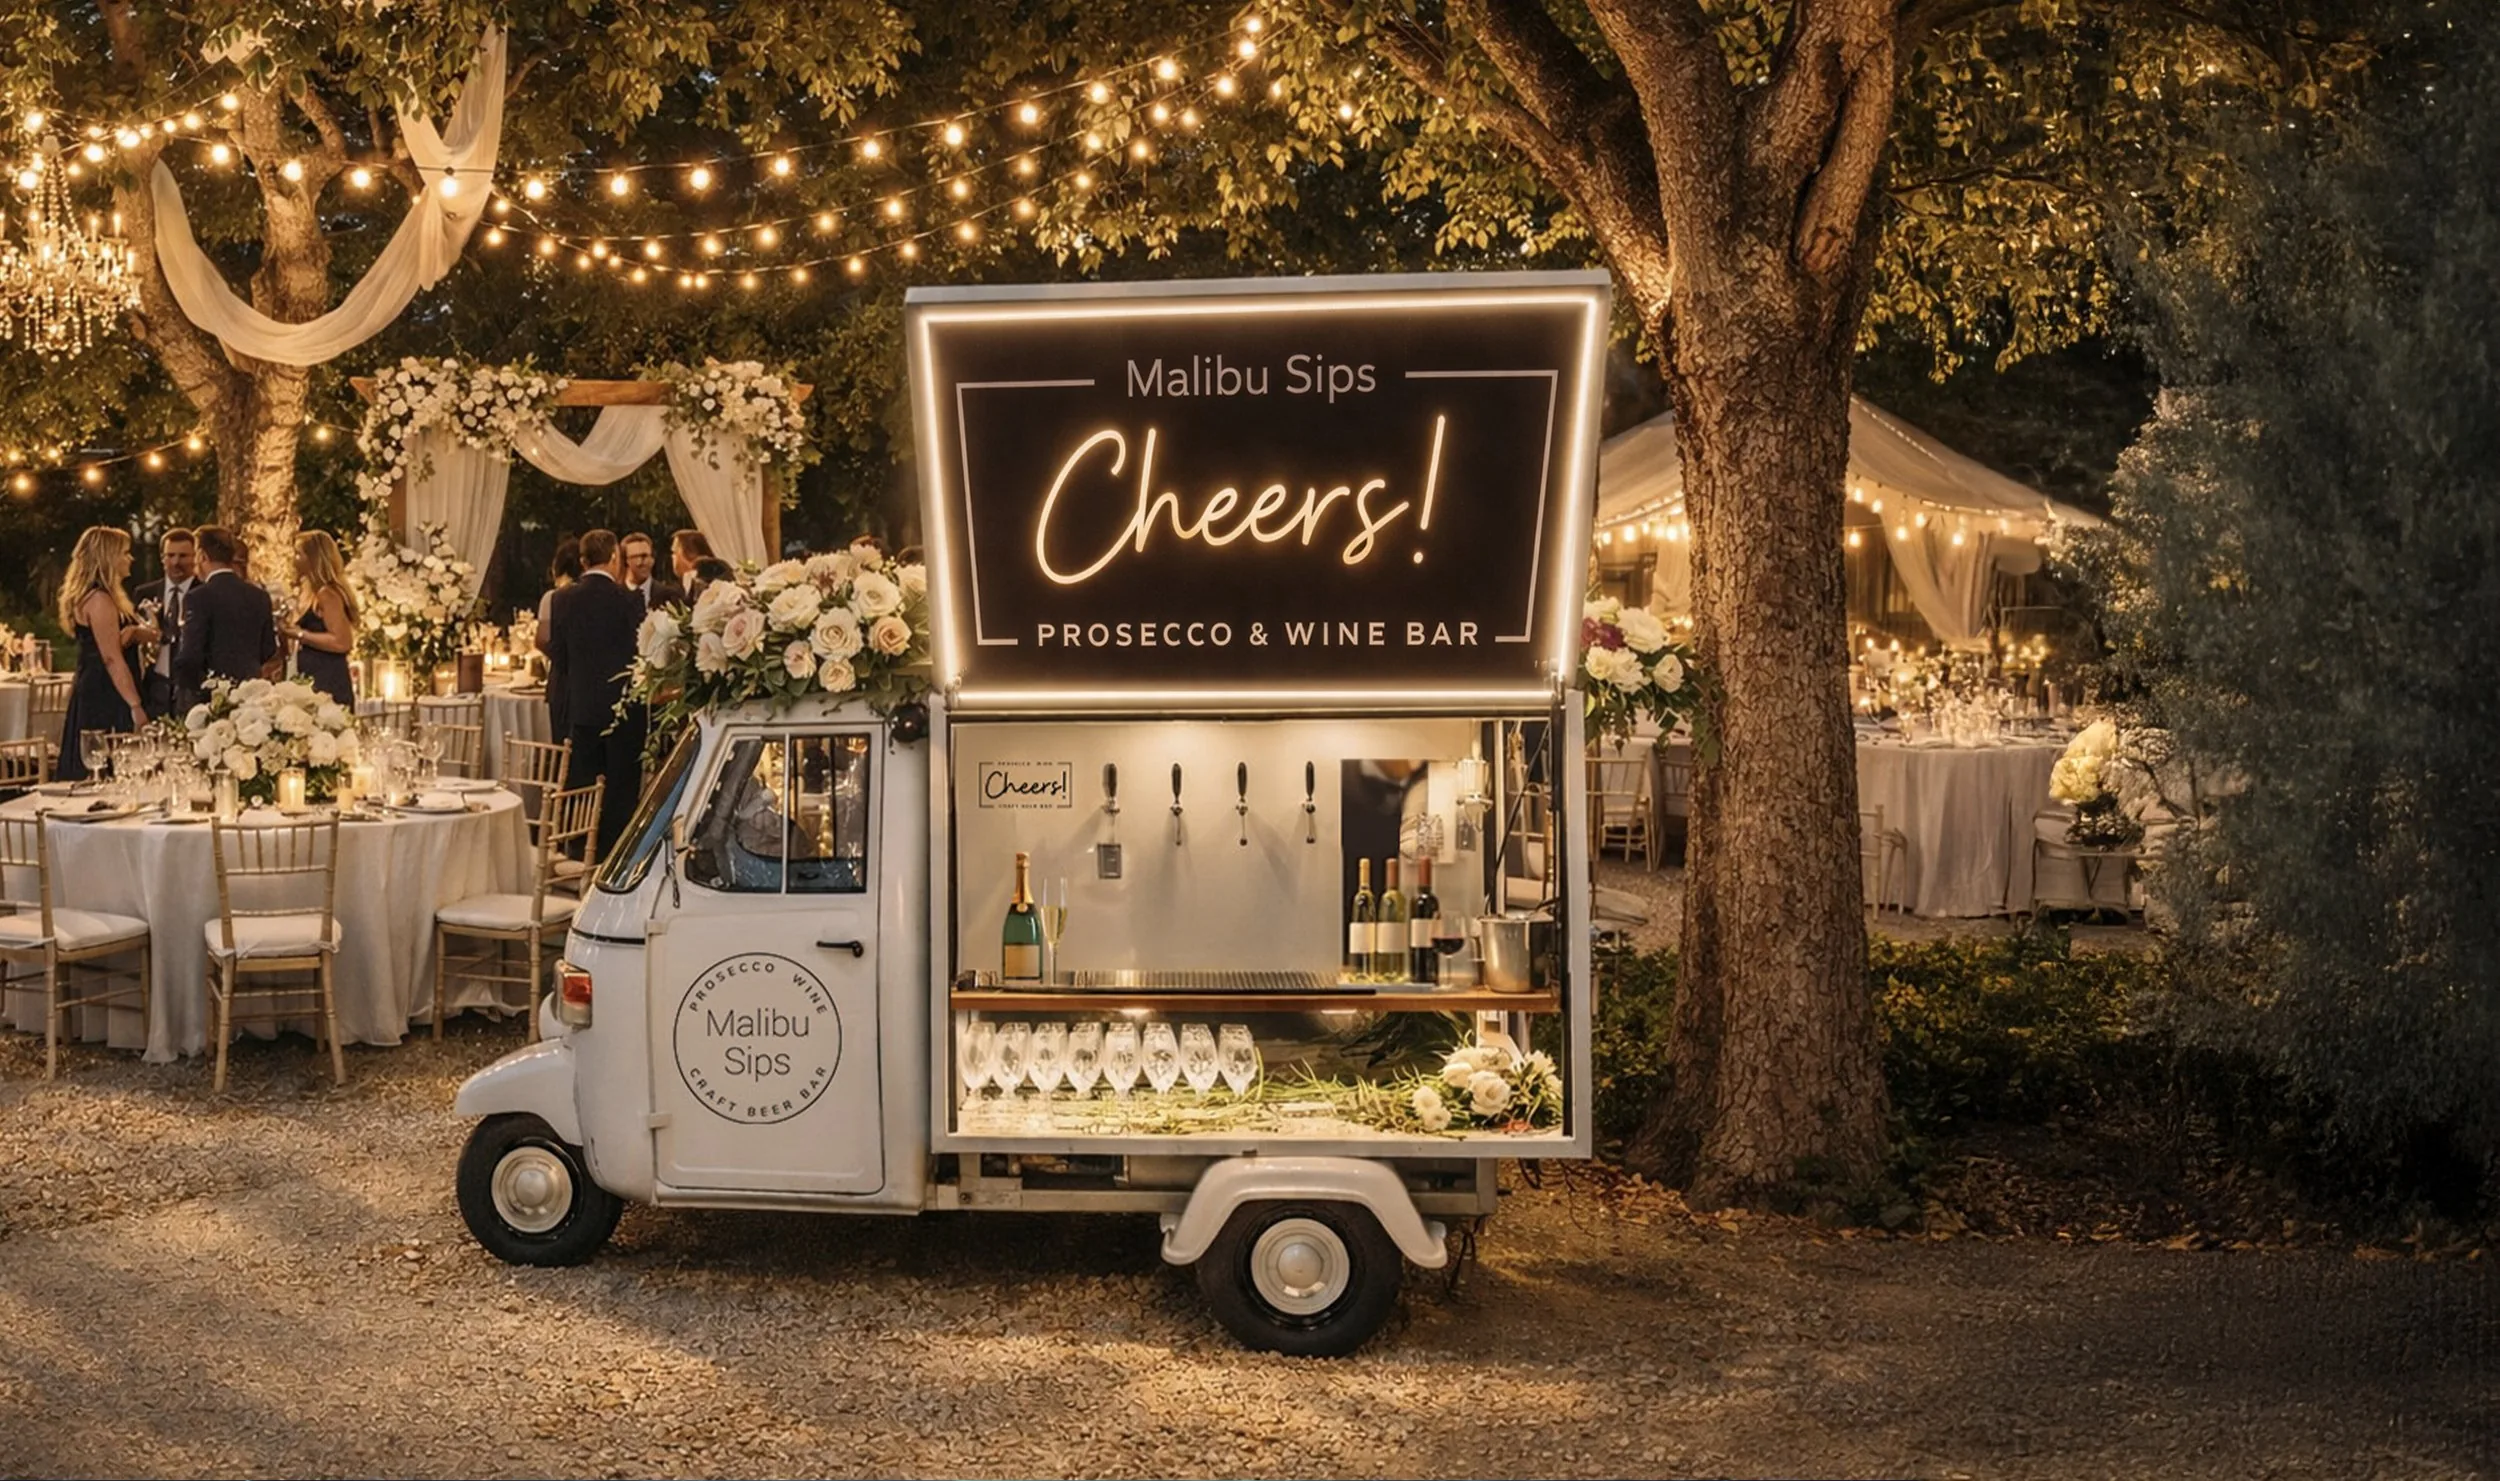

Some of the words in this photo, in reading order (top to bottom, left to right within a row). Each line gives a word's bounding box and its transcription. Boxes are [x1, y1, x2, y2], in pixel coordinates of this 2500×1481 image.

[1126, 354, 1269, 398] Malibu
[1285, 353, 1377, 403] Sips
[1035, 414, 1446, 585] Cheers!
[1036, 621, 1233, 647] PROSECCO
[1248, 621, 1270, 647] &
[1284, 621, 1386, 646] WINE
[1406, 620, 1479, 646] BAR
[984, 770, 1067, 800] Cheers!
[689, 961, 775, 1012] PROSECCO
[792, 973, 828, 1015] WINE
[706, 1007, 809, 1038] Malibu
[724, 1045, 791, 1083] Sips
[689, 1067, 737, 1112] CRAFT
[747, 1099, 793, 1117] BEER
[799, 1066, 827, 1100] BAR
